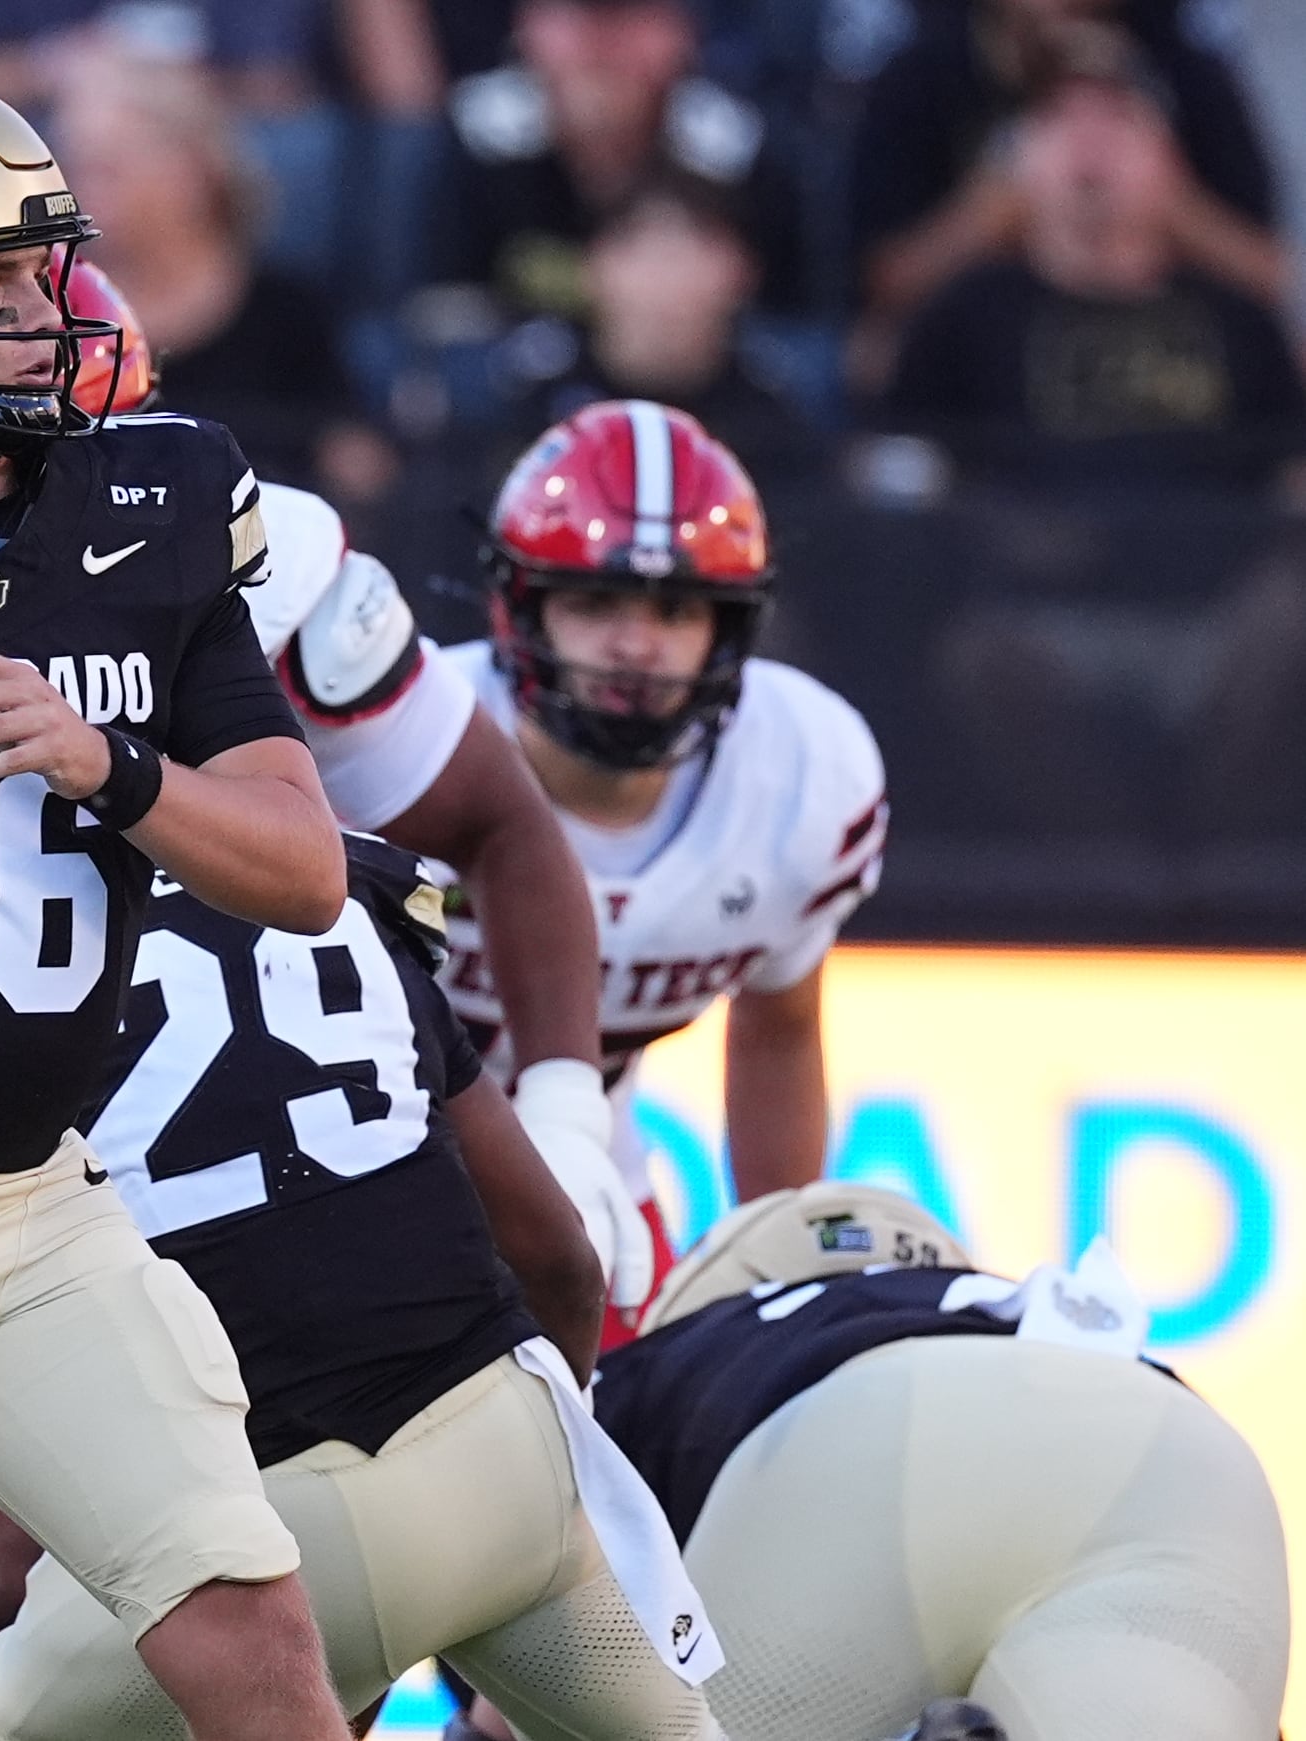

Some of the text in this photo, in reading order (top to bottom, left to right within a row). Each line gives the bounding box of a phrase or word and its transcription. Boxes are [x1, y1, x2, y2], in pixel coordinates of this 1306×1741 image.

[44, 193, 77, 217] BUFFS
[109, 484, 168, 506] DP 7
[84, 896, 431, 1241] 29
